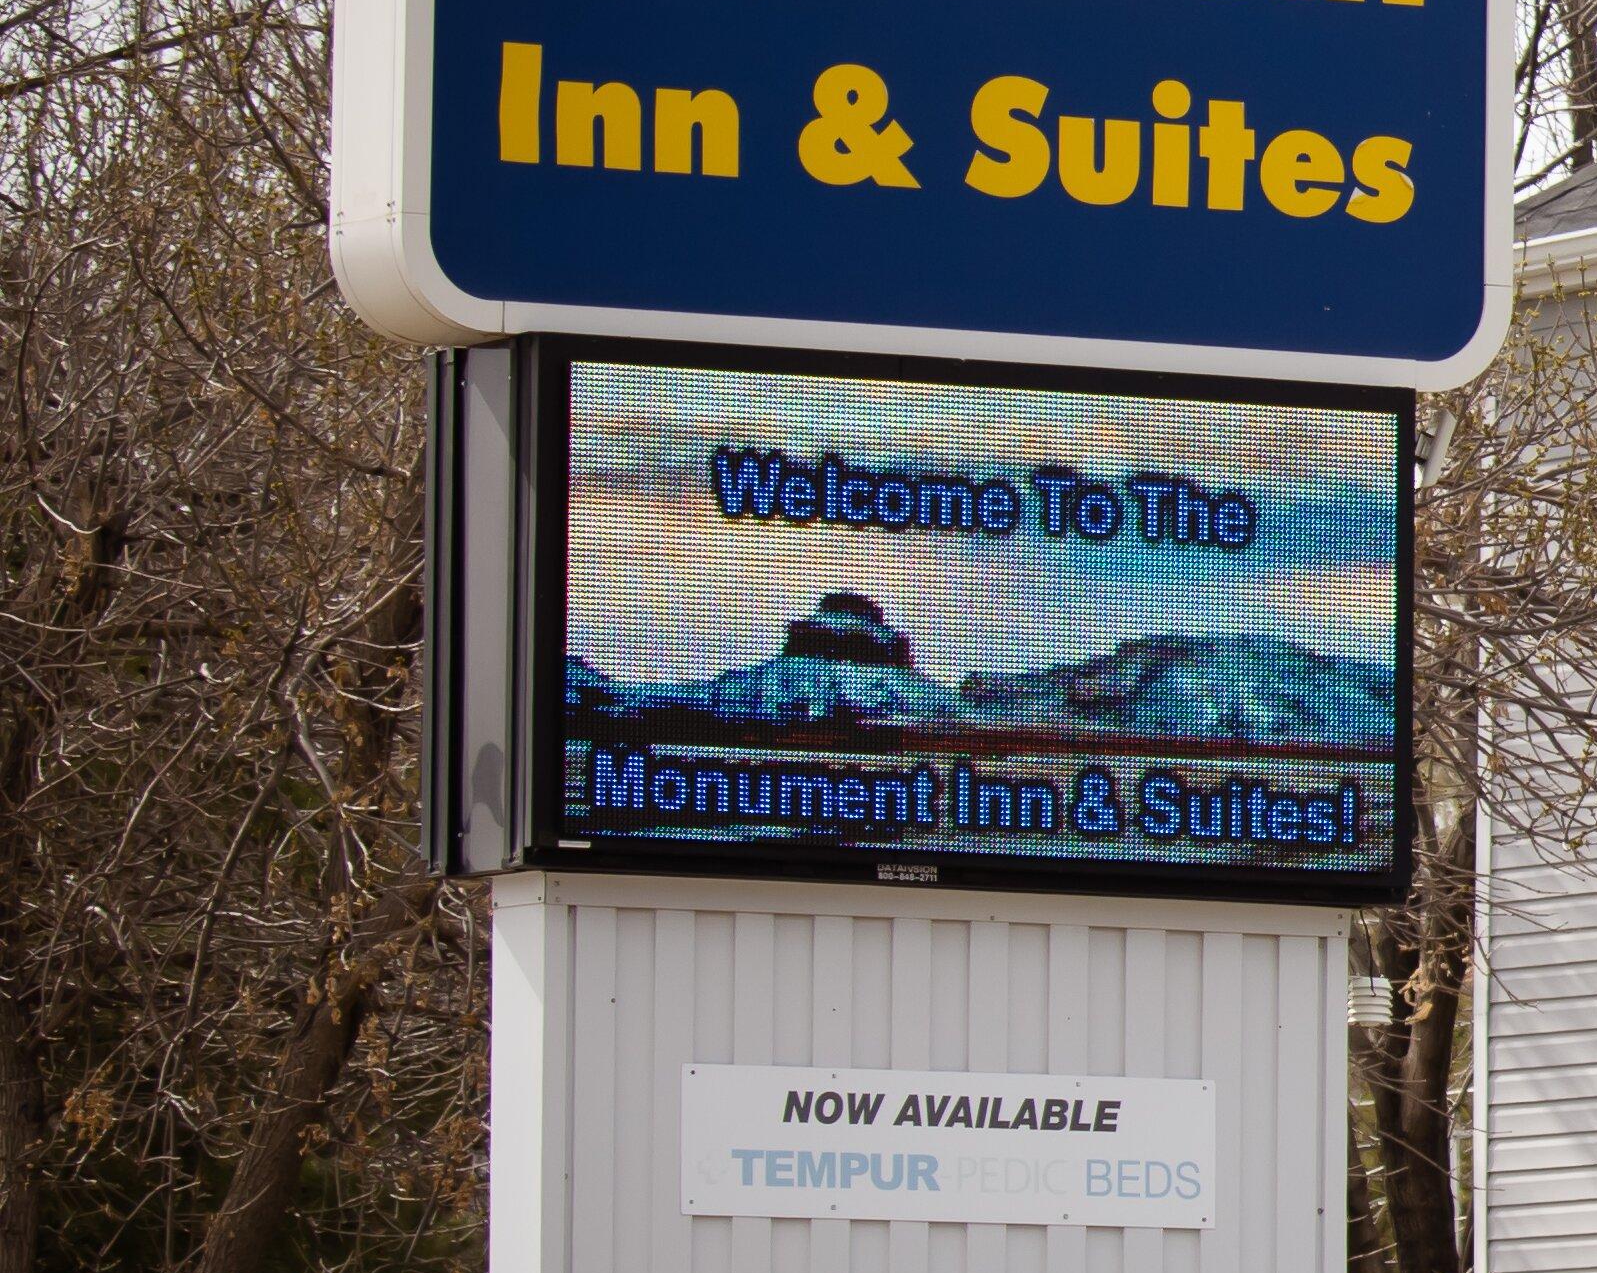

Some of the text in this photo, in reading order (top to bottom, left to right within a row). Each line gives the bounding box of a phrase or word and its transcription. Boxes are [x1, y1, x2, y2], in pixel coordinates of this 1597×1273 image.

[499, 42, 1415, 224] Inn & Suites
[714, 451, 1252, 545] Welcome To The
[594, 750, 1357, 845] Monument Inn & Suites!
[782, 1090, 1122, 1133] NOW AVAILABLE
[1085, 1159, 1202, 1200] BEDS
